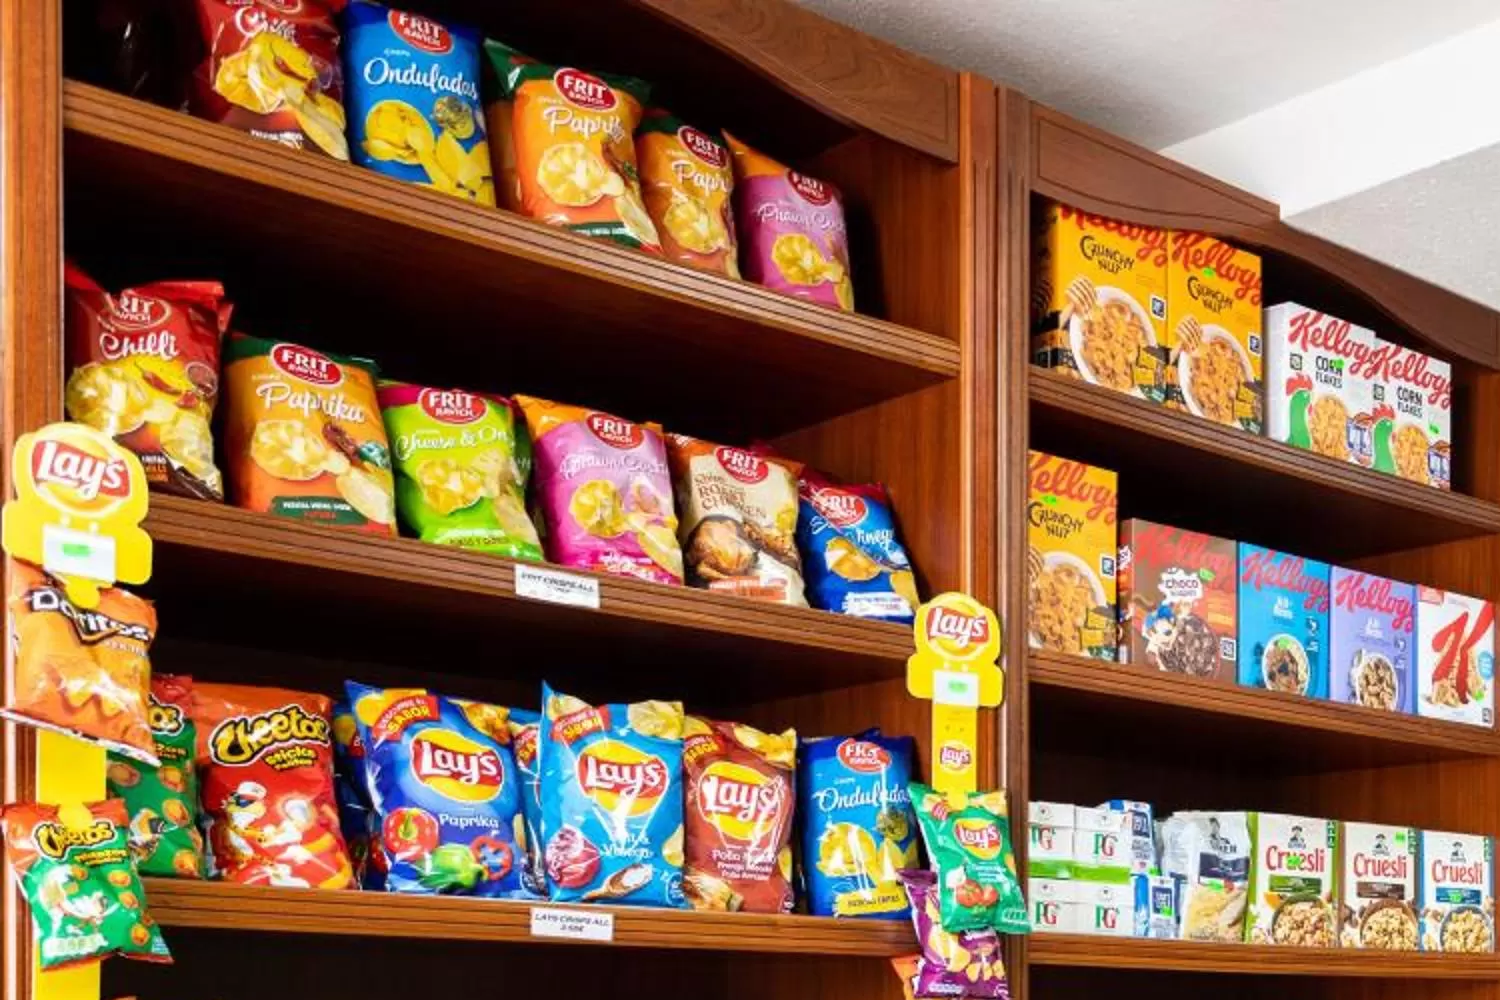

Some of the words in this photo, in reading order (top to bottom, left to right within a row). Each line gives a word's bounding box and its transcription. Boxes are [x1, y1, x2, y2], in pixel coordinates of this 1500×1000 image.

[363, 57, 478, 99] Onduladas
[563, 75, 607, 100] FRIT
[686, 132, 722, 157] FRIT
[281, 349, 331, 372] FRIT
[256, 382, 364, 424] Paprika
[429, 391, 475, 410] FRIT
[1396, 386, 1423, 407] CORN
[592, 417, 633, 438] FRIT
[35, 442, 125, 499] Lay's
[723, 449, 765, 471] FRIT
[929, 606, 987, 645] Lay's
[419, 740, 500, 785] Lay's
[584, 754, 663, 798] Lay's
[701, 775, 781, 822] Lay's
[439, 813, 500, 831] Paprika
[957, 824, 999, 847] Lay's
[1093, 832, 1119, 857] PG
[1353, 853, 1408, 879] Cruesli
[1431, 859, 1484, 885] Cruesli
[1035, 901, 1060, 925] PG
[1095, 904, 1120, 929] PG
